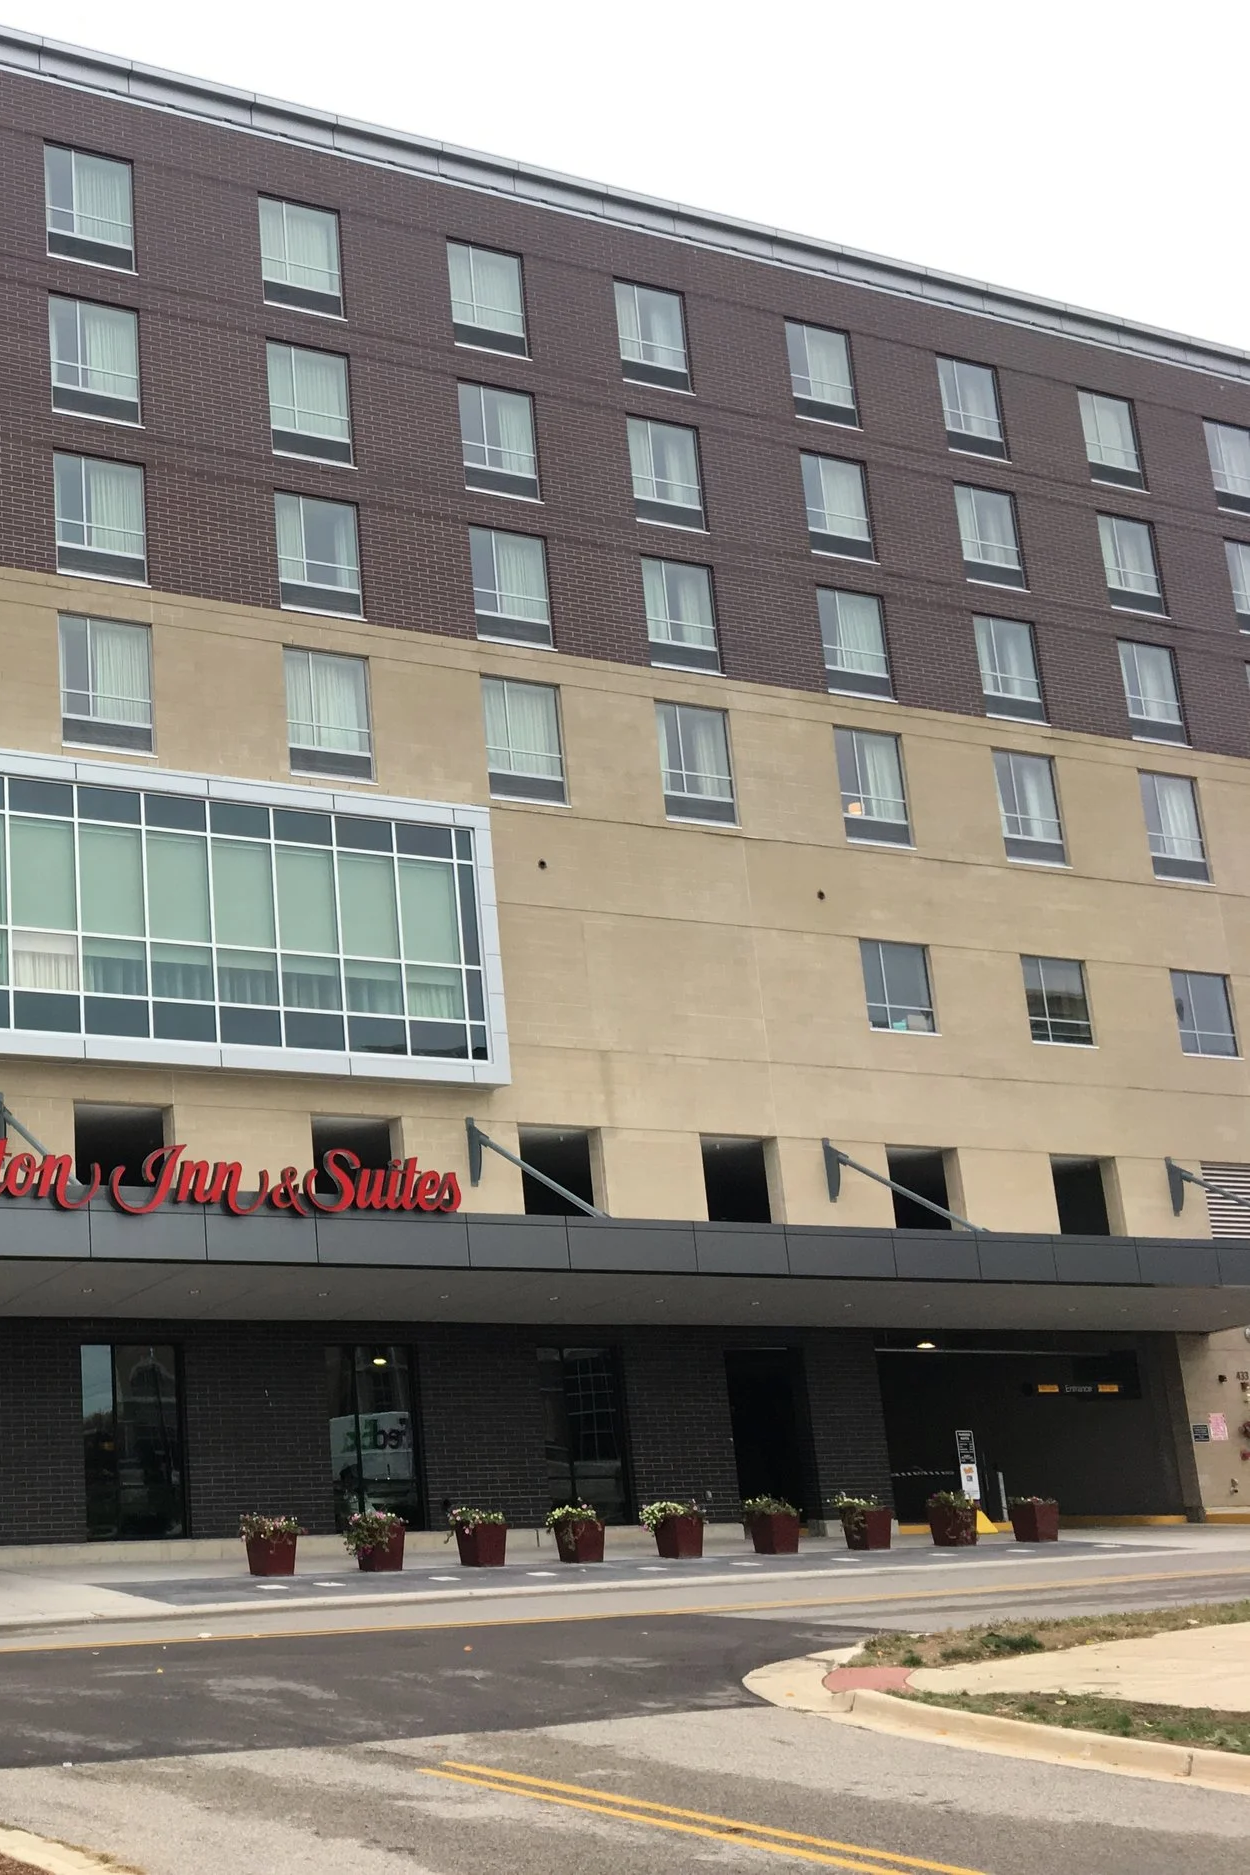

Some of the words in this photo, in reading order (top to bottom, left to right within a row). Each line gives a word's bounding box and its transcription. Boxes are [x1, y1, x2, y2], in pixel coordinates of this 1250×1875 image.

[110, 1143, 269, 1216] Inn
[269, 1166, 308, 1217] &
[303, 1148, 462, 1214] Suites
[1236, 1371, 1249, 1381] 433
[1065, 1385, 1093, 1393] Entrance
